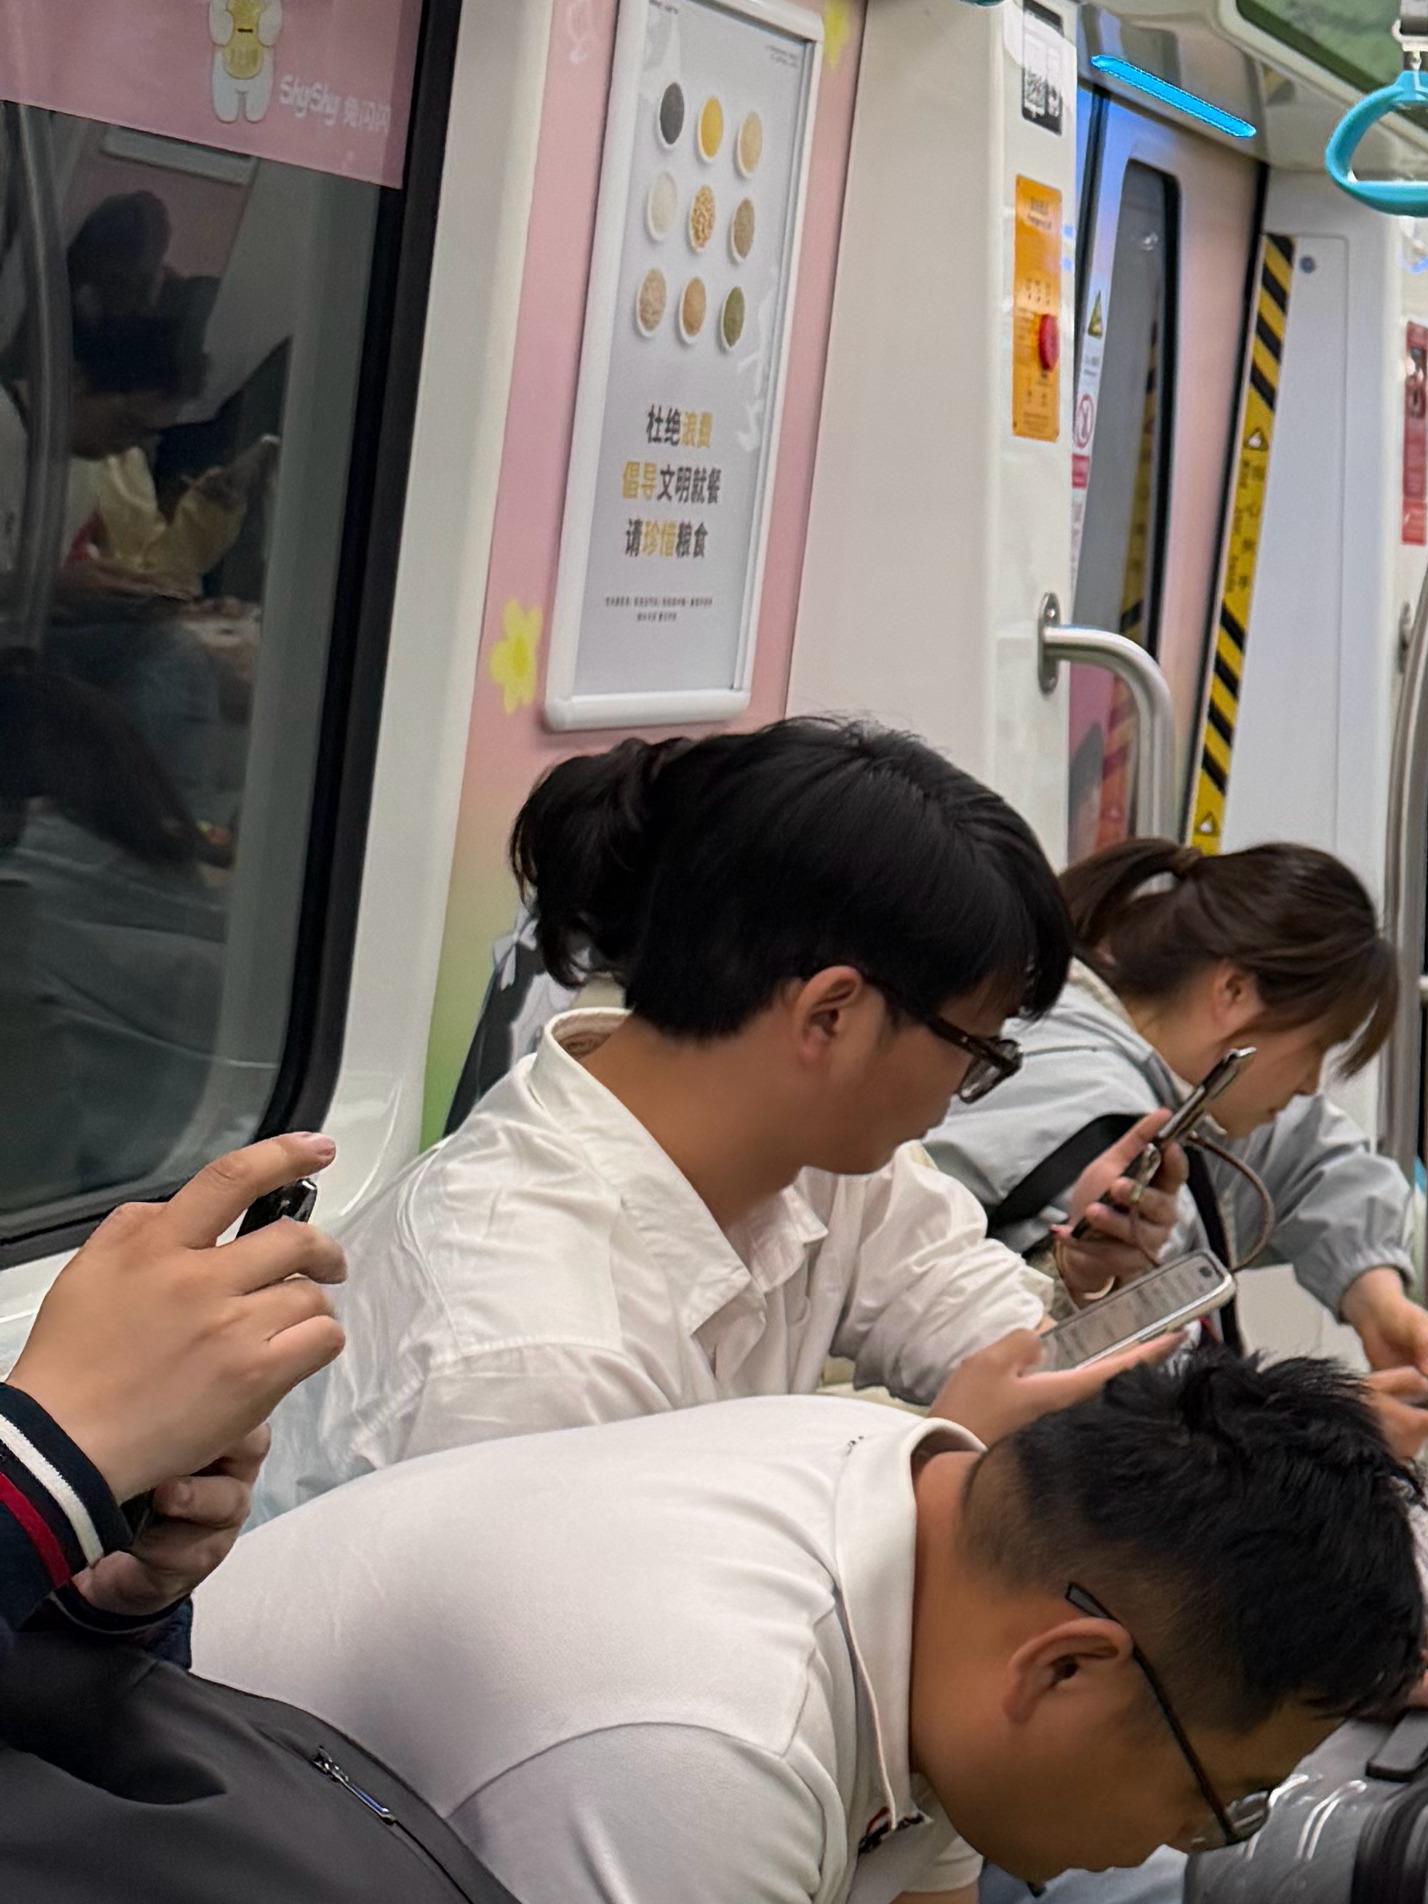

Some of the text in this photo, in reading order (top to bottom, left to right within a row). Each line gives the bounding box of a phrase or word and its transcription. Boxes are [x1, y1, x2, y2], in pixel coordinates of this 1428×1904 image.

[645, 403, 715, 449] 杜绝浪费
[621, 460, 722, 505] 倡导文明就餐
[624, 517, 709, 559] 请珍惜粮食
